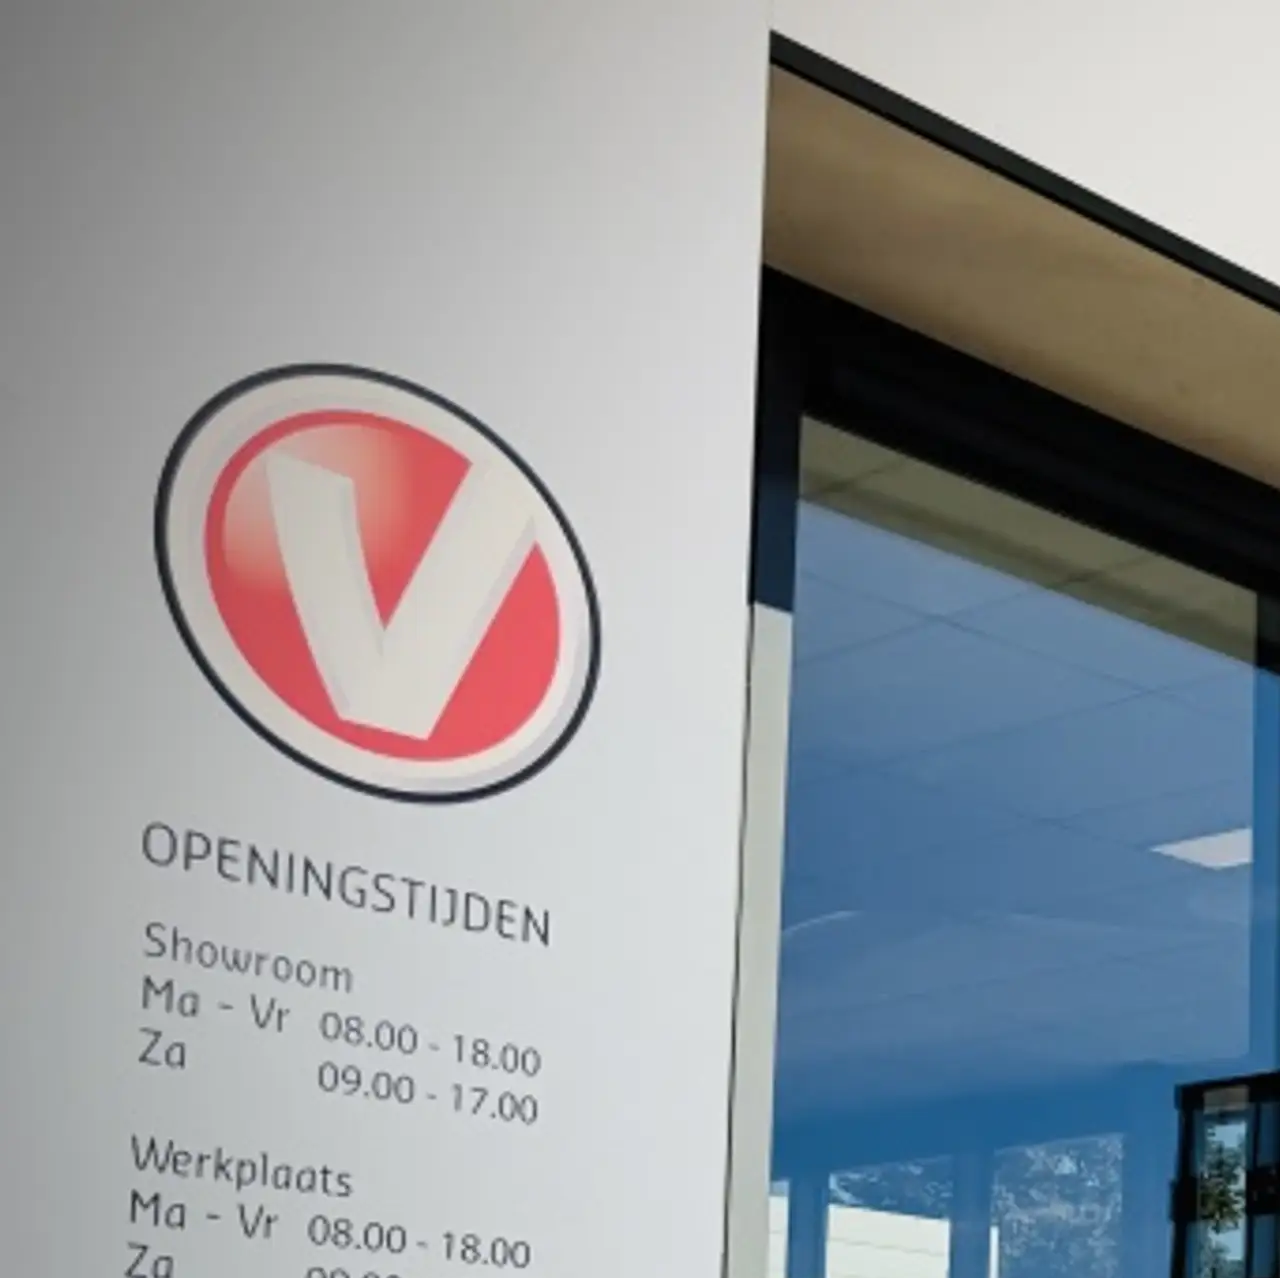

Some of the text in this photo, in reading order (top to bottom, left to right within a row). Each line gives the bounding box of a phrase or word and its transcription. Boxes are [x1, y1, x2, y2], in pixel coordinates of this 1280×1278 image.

[265, 450, 538, 742] V
[141, 821, 551, 948] OPENINGSTIJDEN
[144, 921, 354, 994] Showroom
[137, 1026, 186, 1070] Za
[317, 1060, 416, 1106] 09.00
[452, 1083, 539, 1127] 17.00
[141, 974, 200, 1018] Ma
[249, 993, 291, 1034] Vr
[318, 1011, 418, 1056] 08.00
[453, 1034, 543, 1078] 18.00
[130, 1133, 354, 1199] Werkplaats
[129, 1188, 187, 1231] Ma
[237, 1202, 279, 1240] Vr
[306, 1213, 407, 1256] 08.00
[442, 1230, 532, 1270] 18.00
